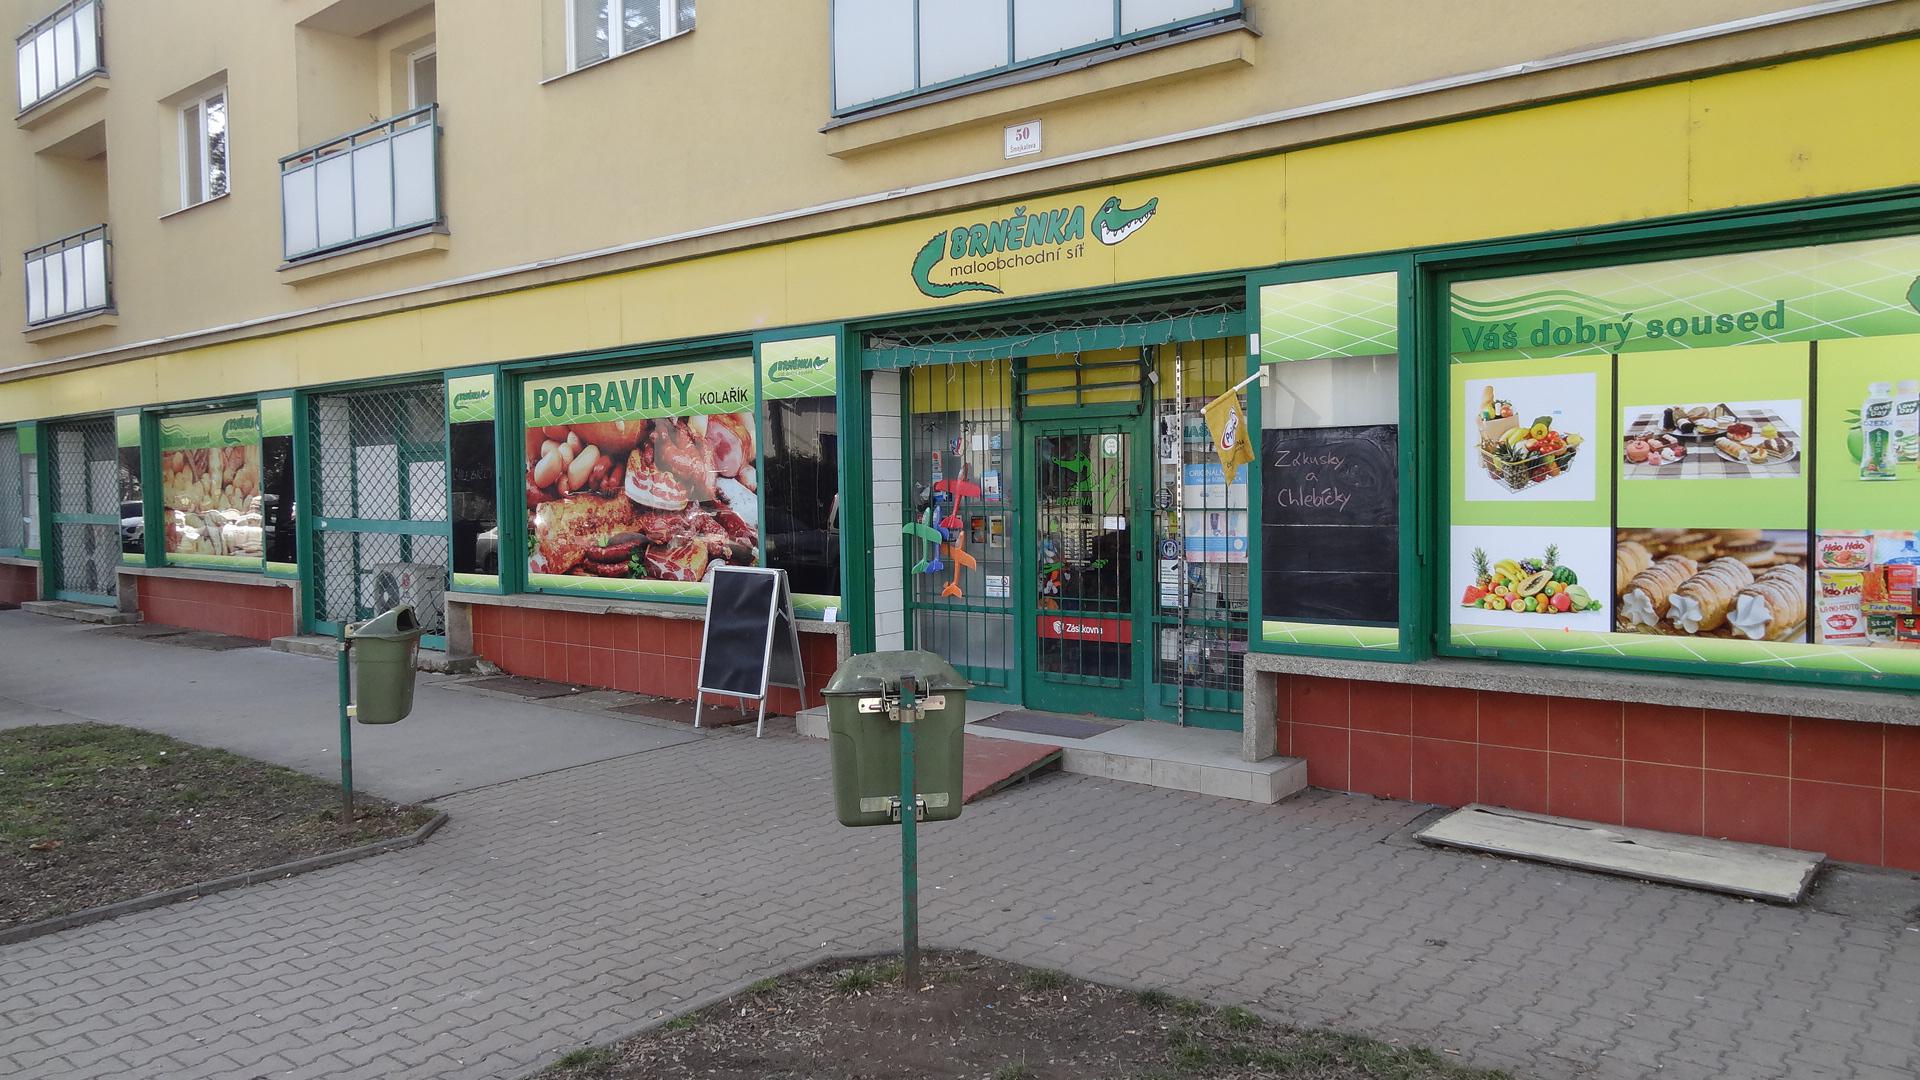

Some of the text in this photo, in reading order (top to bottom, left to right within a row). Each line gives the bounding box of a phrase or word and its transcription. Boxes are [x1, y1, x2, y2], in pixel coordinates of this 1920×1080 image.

[1015, 126, 1030, 141] 50
[949, 205, 1085, 261] BRNĚNKA
[950, 244, 1085, 277] maloobchodní síť
[1462, 299, 1786, 353] Váš dobrý soused
[533, 373, 749, 419] POTRAVINY KOLAŘÍK
[1274, 449, 1345, 471] Zákusky
[1305, 471, 1319, 483] a
[1277, 485, 1352, 513] Chlebíčky
[1065, 623, 1104, 636] Zásikovn
